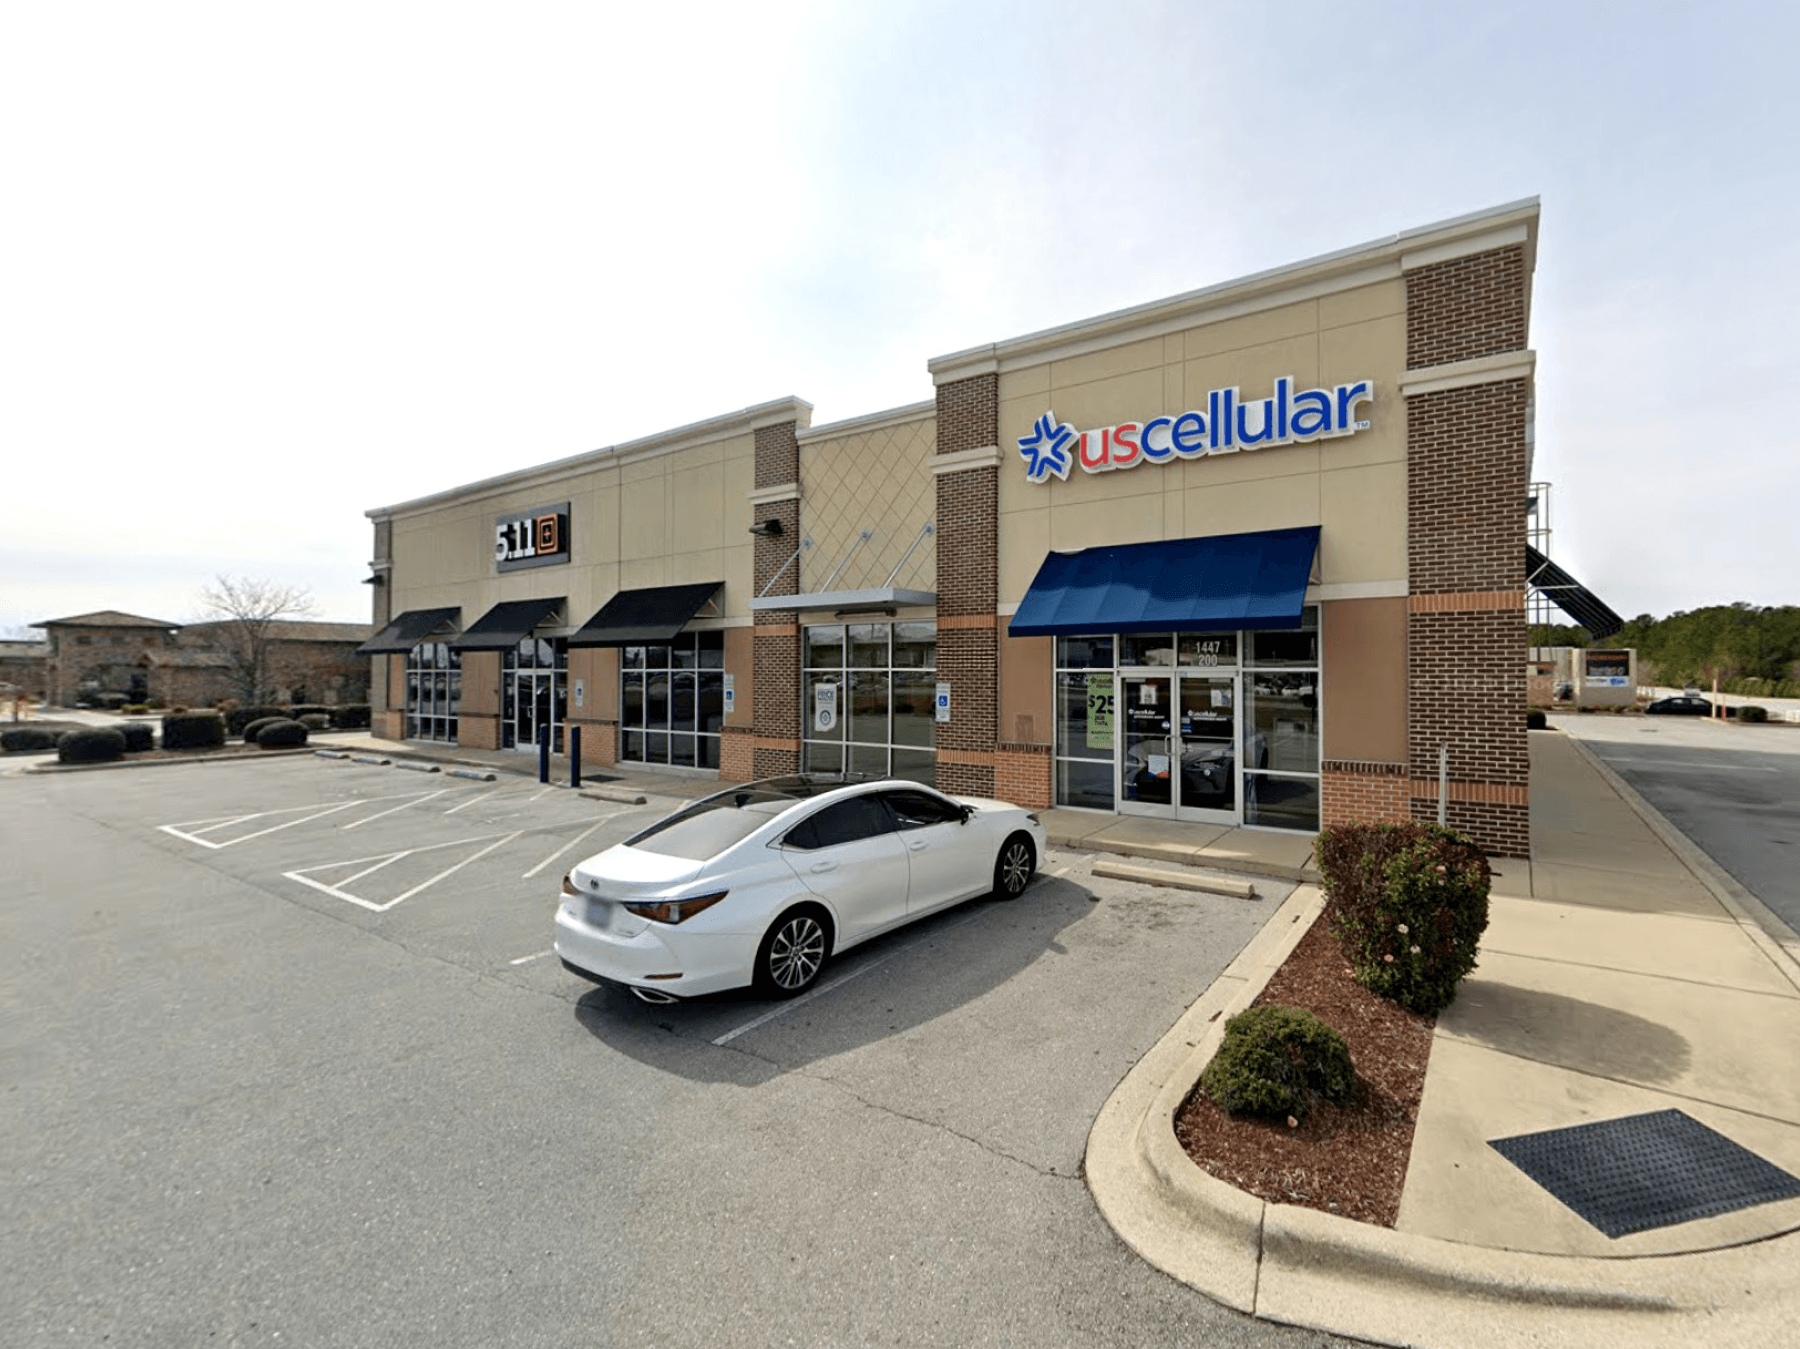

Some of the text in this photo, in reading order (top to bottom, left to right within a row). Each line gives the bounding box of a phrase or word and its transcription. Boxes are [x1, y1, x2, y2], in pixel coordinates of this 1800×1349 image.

[1079, 378, 1367, 468] uscellular
[496, 519, 535, 561] 5.11
[1196, 641, 1220, 653] 1447
[1198, 654, 1218, 667] 200
